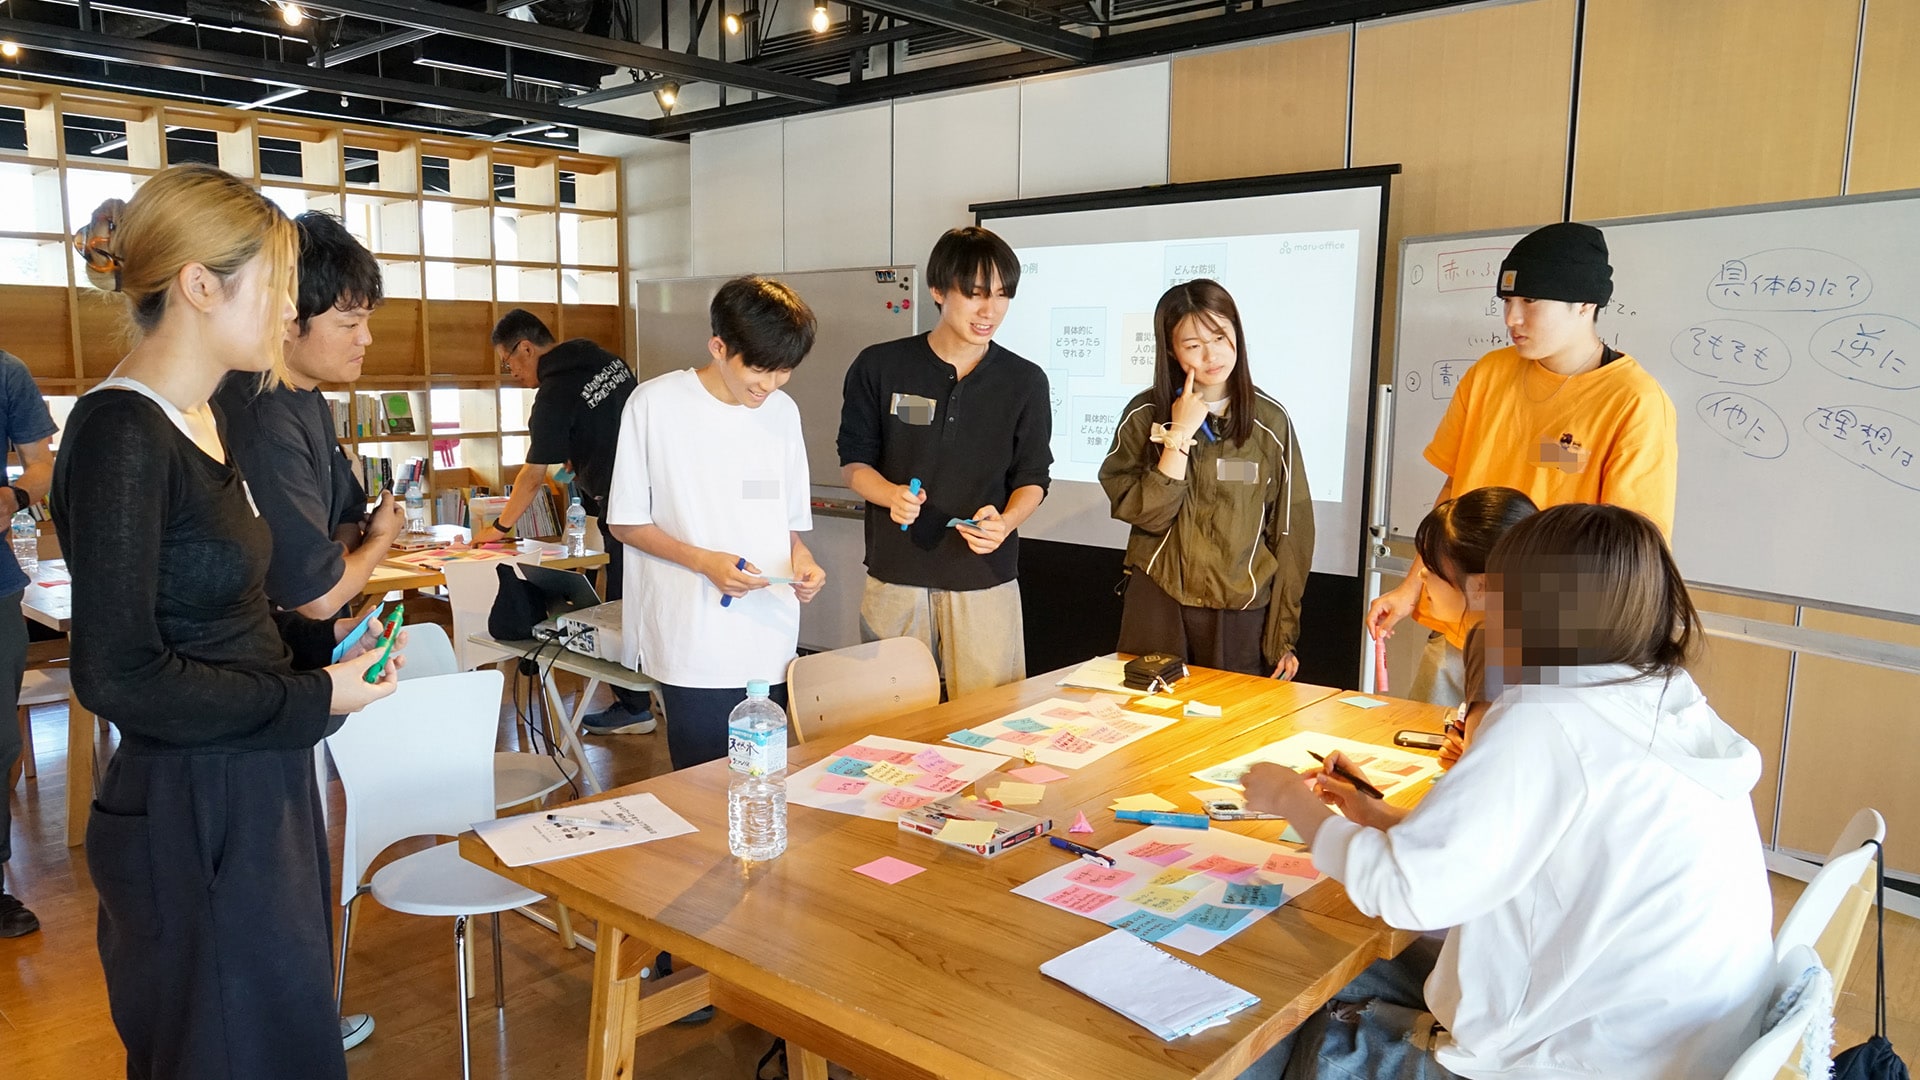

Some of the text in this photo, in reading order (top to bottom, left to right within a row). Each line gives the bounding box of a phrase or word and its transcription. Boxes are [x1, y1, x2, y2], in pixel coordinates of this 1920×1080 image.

[1174, 263, 1216, 275] どんな防災
[1715, 259, 1860, 298] 具体的に？
[1063, 326, 1093, 336] 具体的に
[1055, 337, 1101, 347] どうやったら
[1830, 322, 1907, 374] 逆に
[1062, 348, 1092, 358] 守れる？
[1689, 327, 1769, 371] そもそも
[1084, 413, 1115, 423] 具体的に
[1706, 396, 1766, 443] 他に
[1087, 437, 1109, 446] 対象？
[1816, 407, 1914, 468] 理想は
